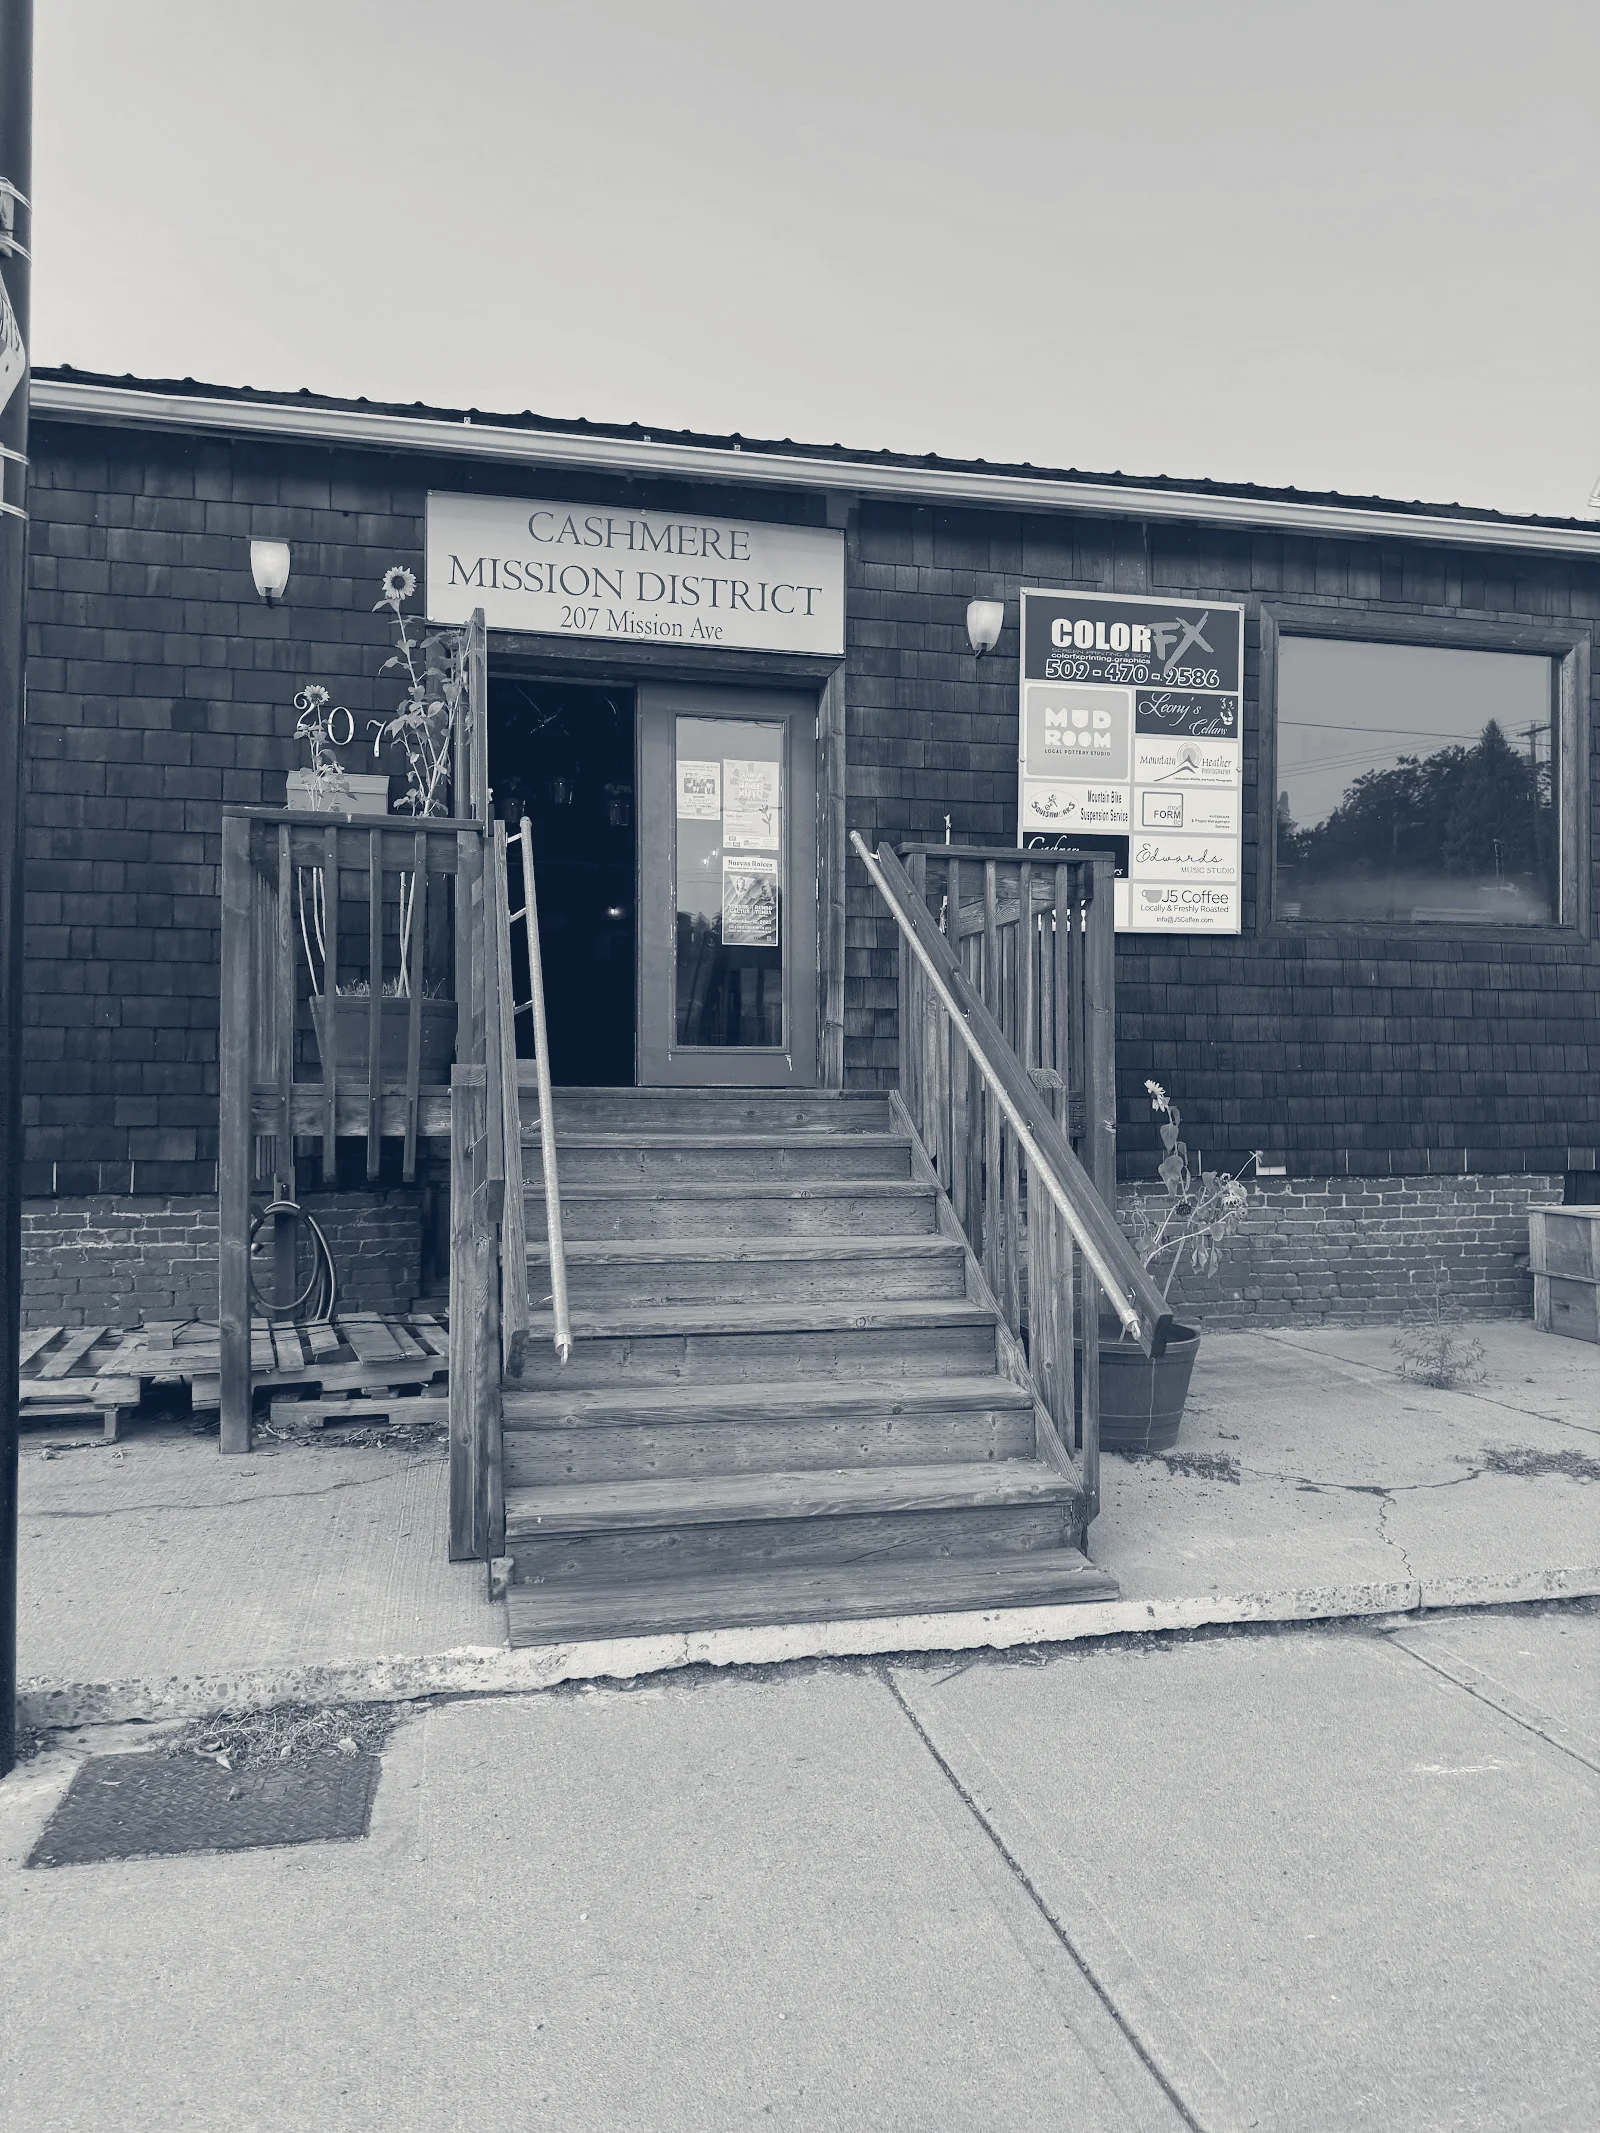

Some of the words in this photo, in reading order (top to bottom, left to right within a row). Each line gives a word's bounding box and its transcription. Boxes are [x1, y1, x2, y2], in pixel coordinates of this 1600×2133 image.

[528, 511, 752, 562] CASHMERE
[448, 554, 624, 600] MISSION
[636, 571, 823, 617] DISTRICT
[560, 605, 599, 631] 207
[606, 608, 683, 638] Mission
[690, 616, 724, 641] Ave
[1051, 652, 1151, 664] colorfxprinting.graphics
[1045, 707, 1112, 729] MUD
[1044, 729, 1111, 749] ROOM
[1139, 755, 1176, 766] Mountain
[1202, 756, 1232, 768] Heather
[1201, 767, 1231, 775] PHOTOGRAPHY
[1087, 789, 1110, 804] Mountain
[1111, 791, 1122, 804] Bike
[1080, 807, 1109, 824] Suspension
[1110, 809, 1128, 822] Service
[1153, 810, 1181, 819] FORM
[1135, 843, 1223, 863] Edwards
[728, 859, 751, 867] Nuevas
[1181, 866, 1205, 874] MUSIC
[1206, 867, 1235, 875] STUDIO
[1162, 889, 1179, 903] J5
[1181, 890, 1229, 904] Coffee
[1140, 904, 1165, 913] Locally
[1173, 905, 1199, 914] Freshly
[1200, 905, 1229, 913] Roasted
